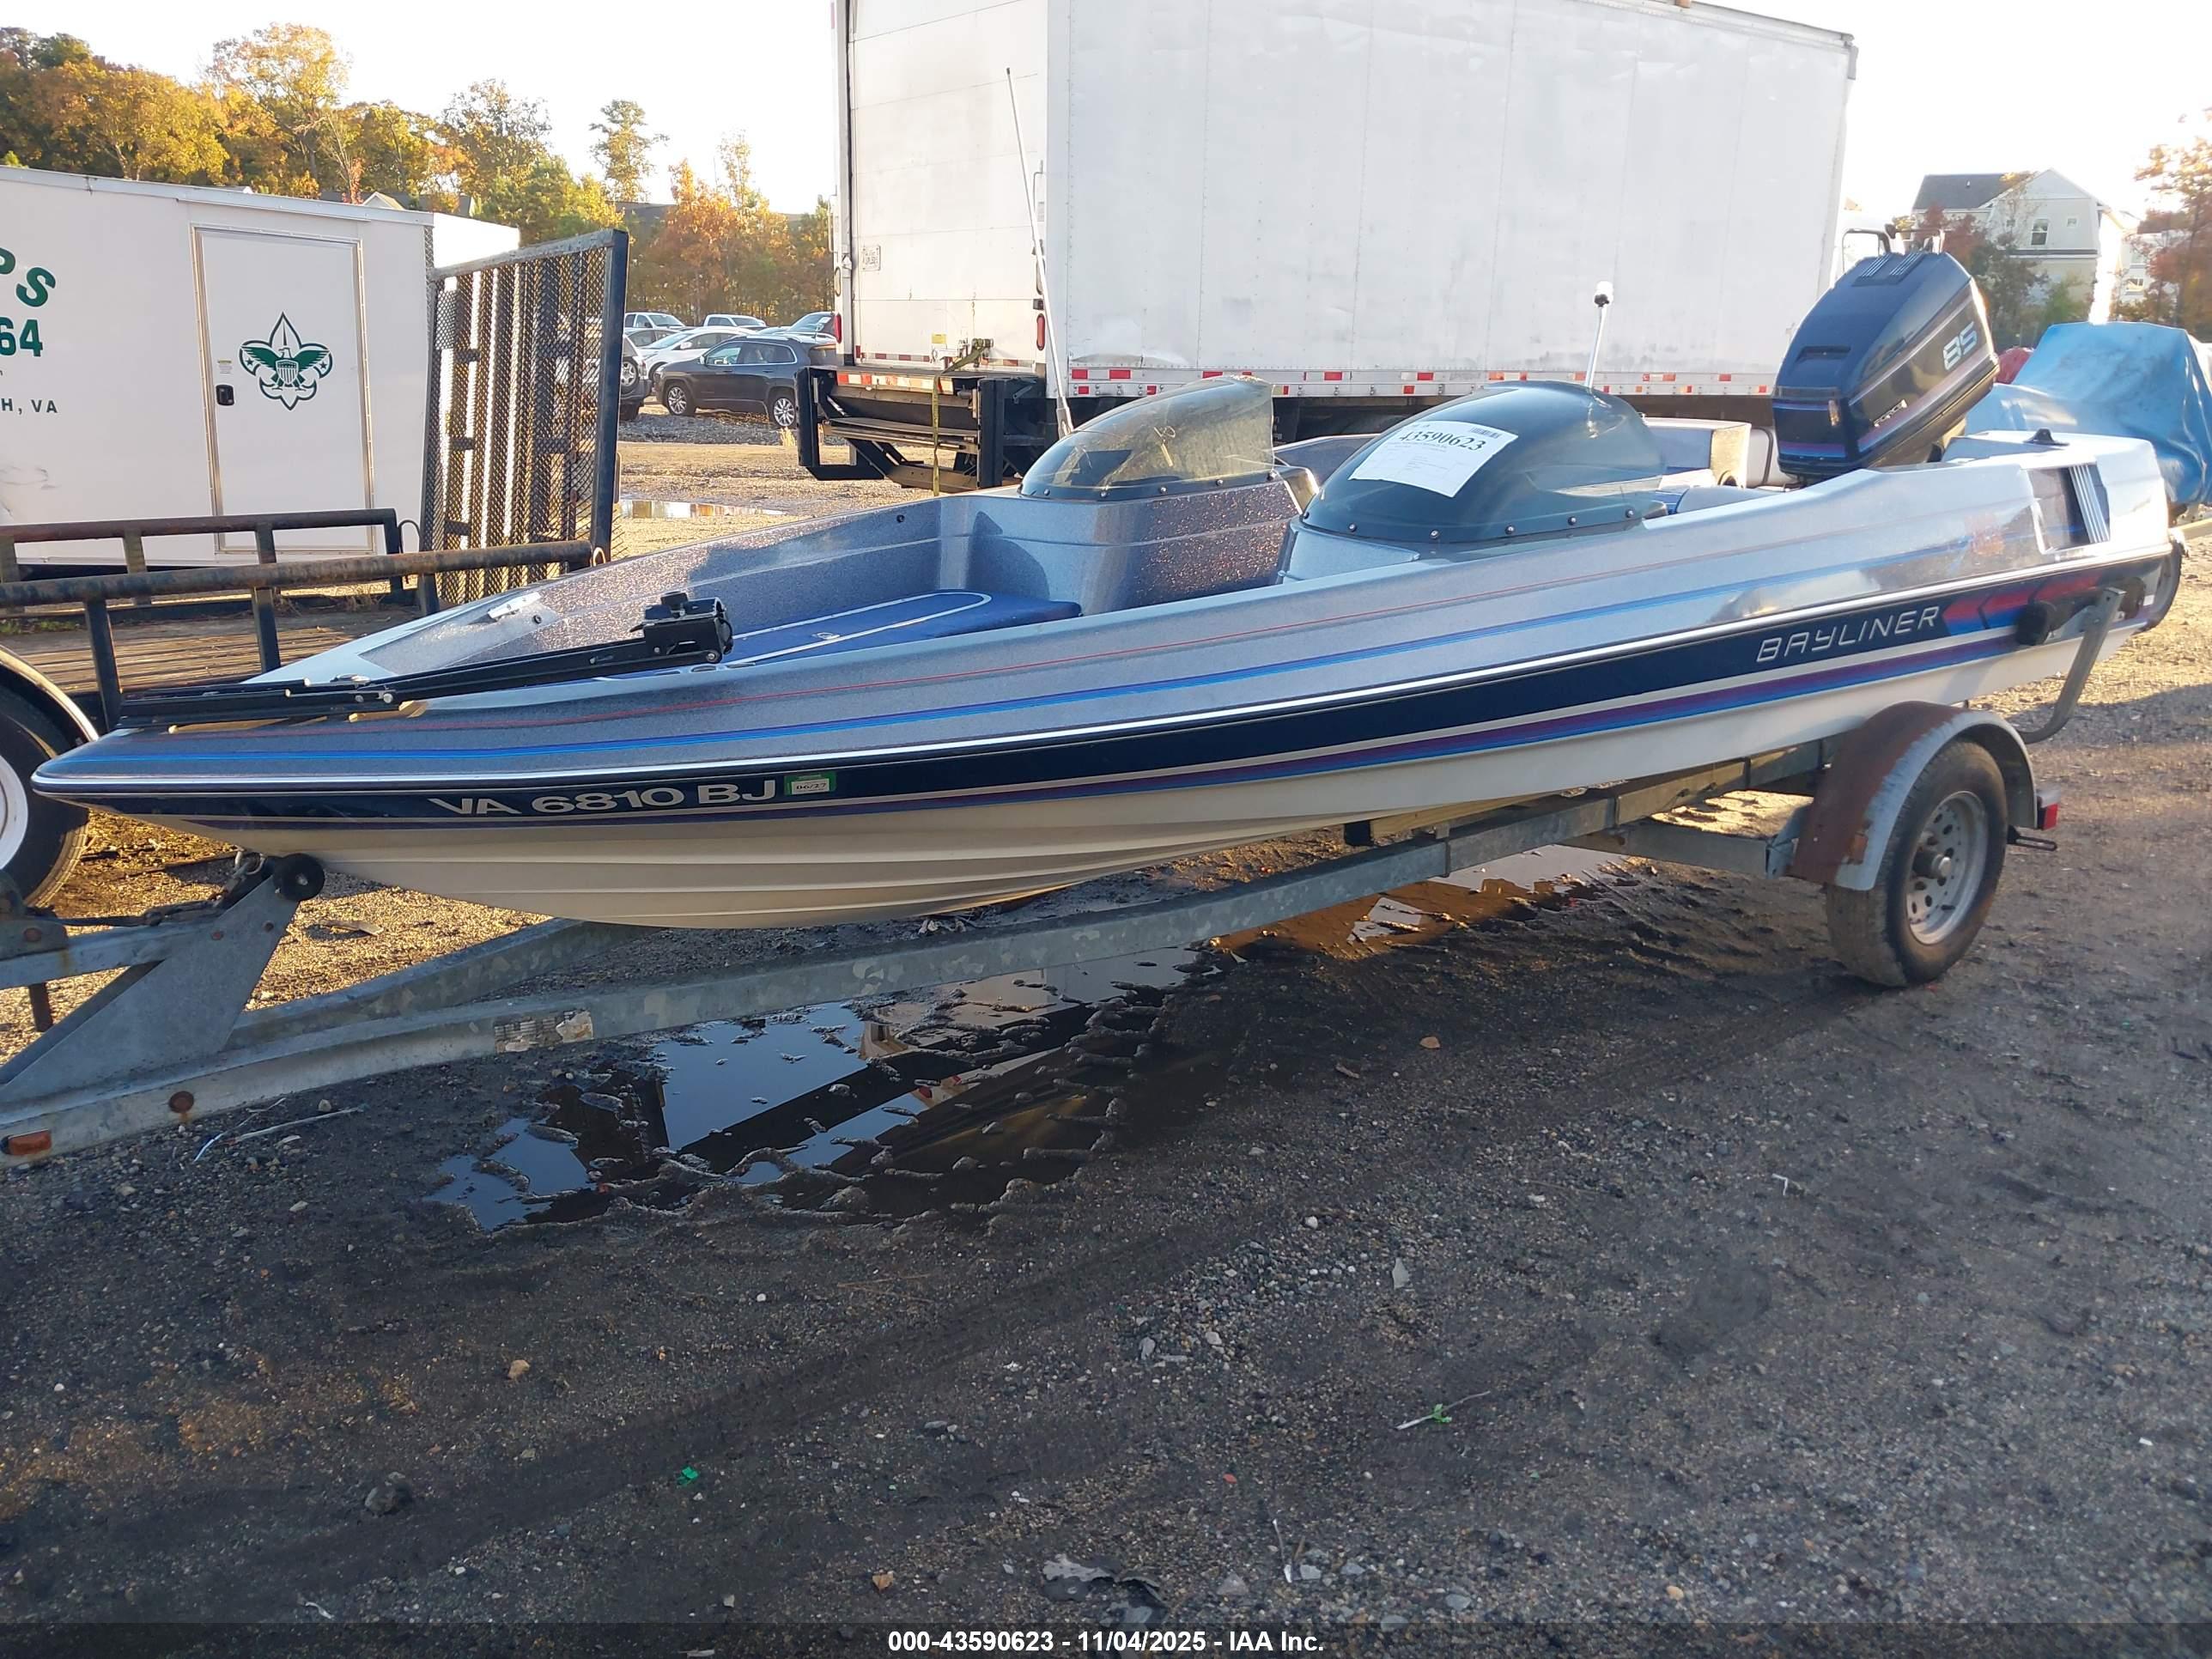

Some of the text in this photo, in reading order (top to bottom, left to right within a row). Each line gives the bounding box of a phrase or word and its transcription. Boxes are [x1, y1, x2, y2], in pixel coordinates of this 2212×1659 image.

[1943, 321, 1978, 370] 85
[31, 399, 58, 413] VA
[1400, 431, 1486, 451] 43590623
[1756, 606, 1940, 662] BAYLINER
[427, 780, 775, 814] VA 6810 BJ
